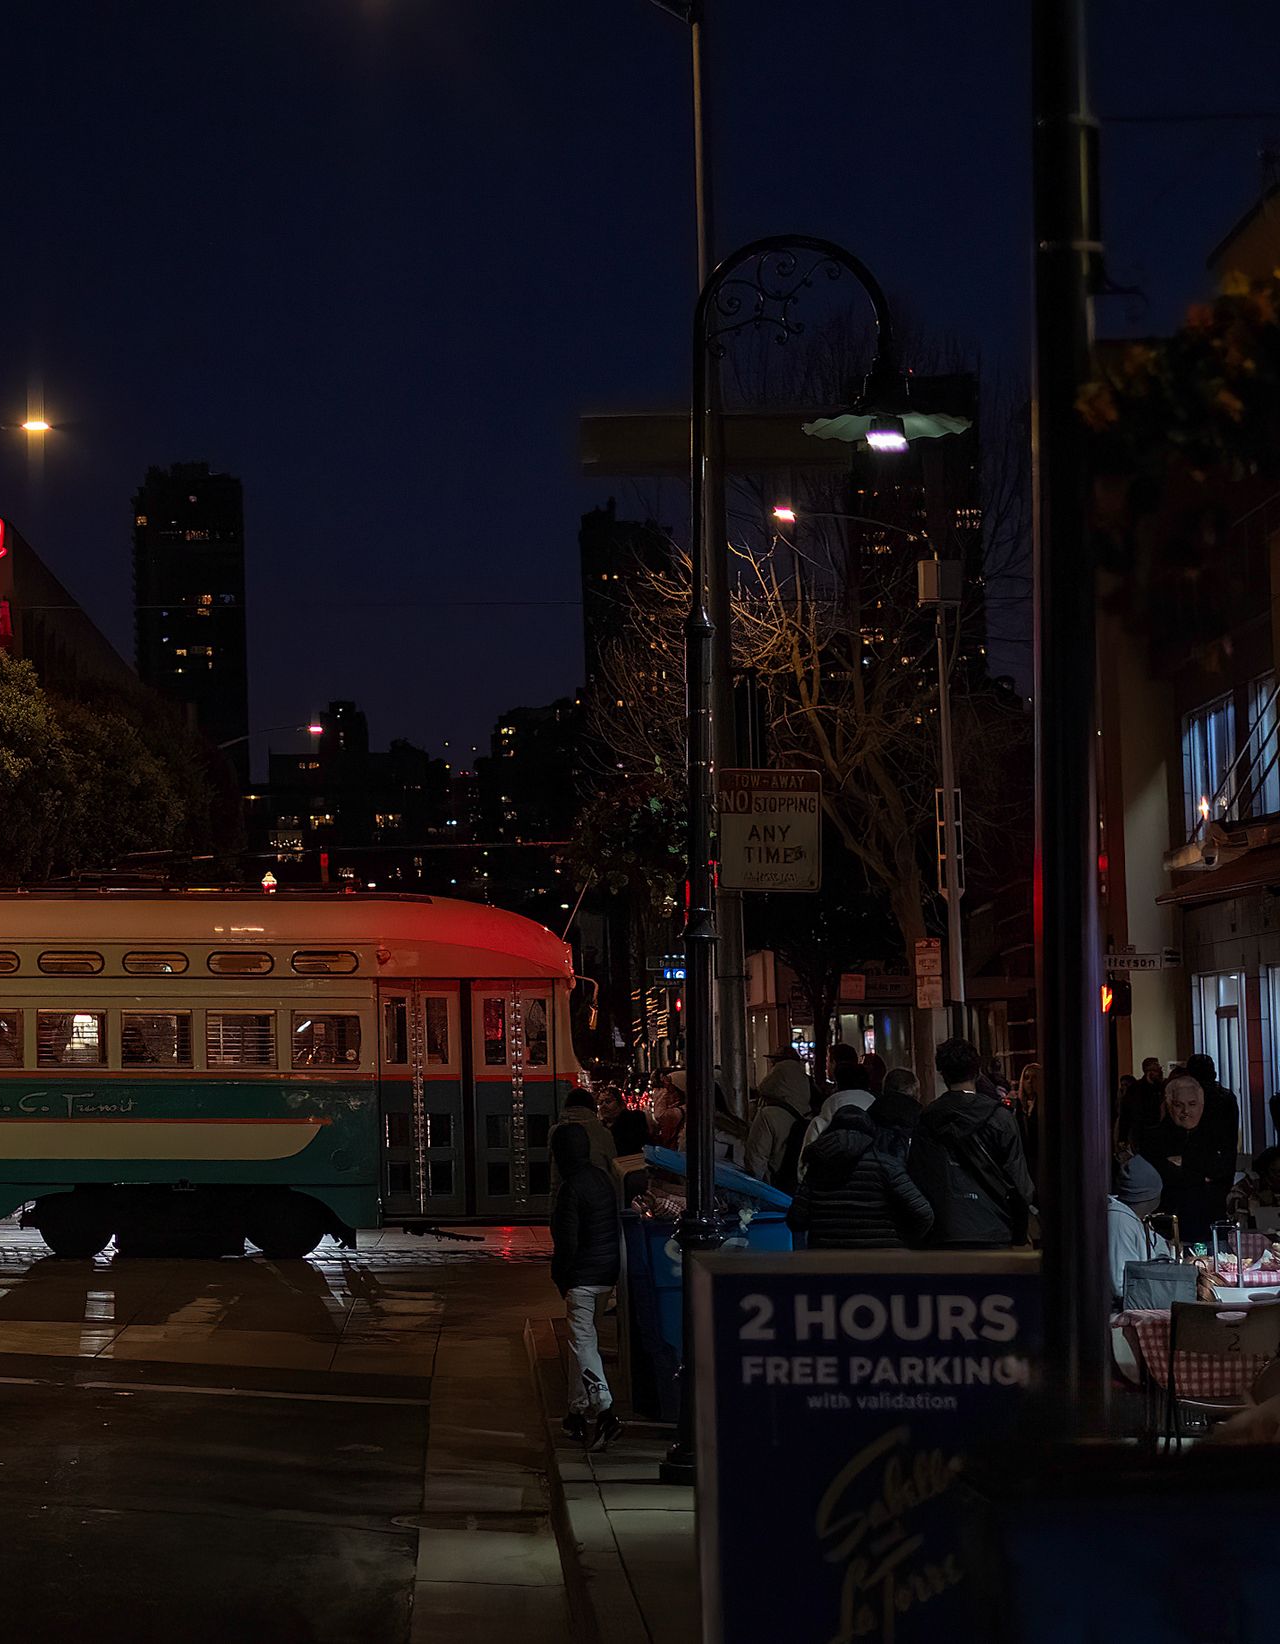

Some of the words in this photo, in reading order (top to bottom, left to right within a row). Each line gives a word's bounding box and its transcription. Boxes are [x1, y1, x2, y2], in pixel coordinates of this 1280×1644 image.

[734, 775, 805, 788] TOW-AWAY
[720, 790, 749, 812] NO
[754, 796, 816, 813] STOPPING
[748, 824, 791, 842] ANY
[744, 846, 795, 864] TIME
[738, 1293, 777, 1341] 2
[793, 1293, 1020, 1342] HOURS
[740, 1355, 840, 1385] FREE
[807, 1392, 851, 1410] with
[857, 1391, 958, 1410] validation
